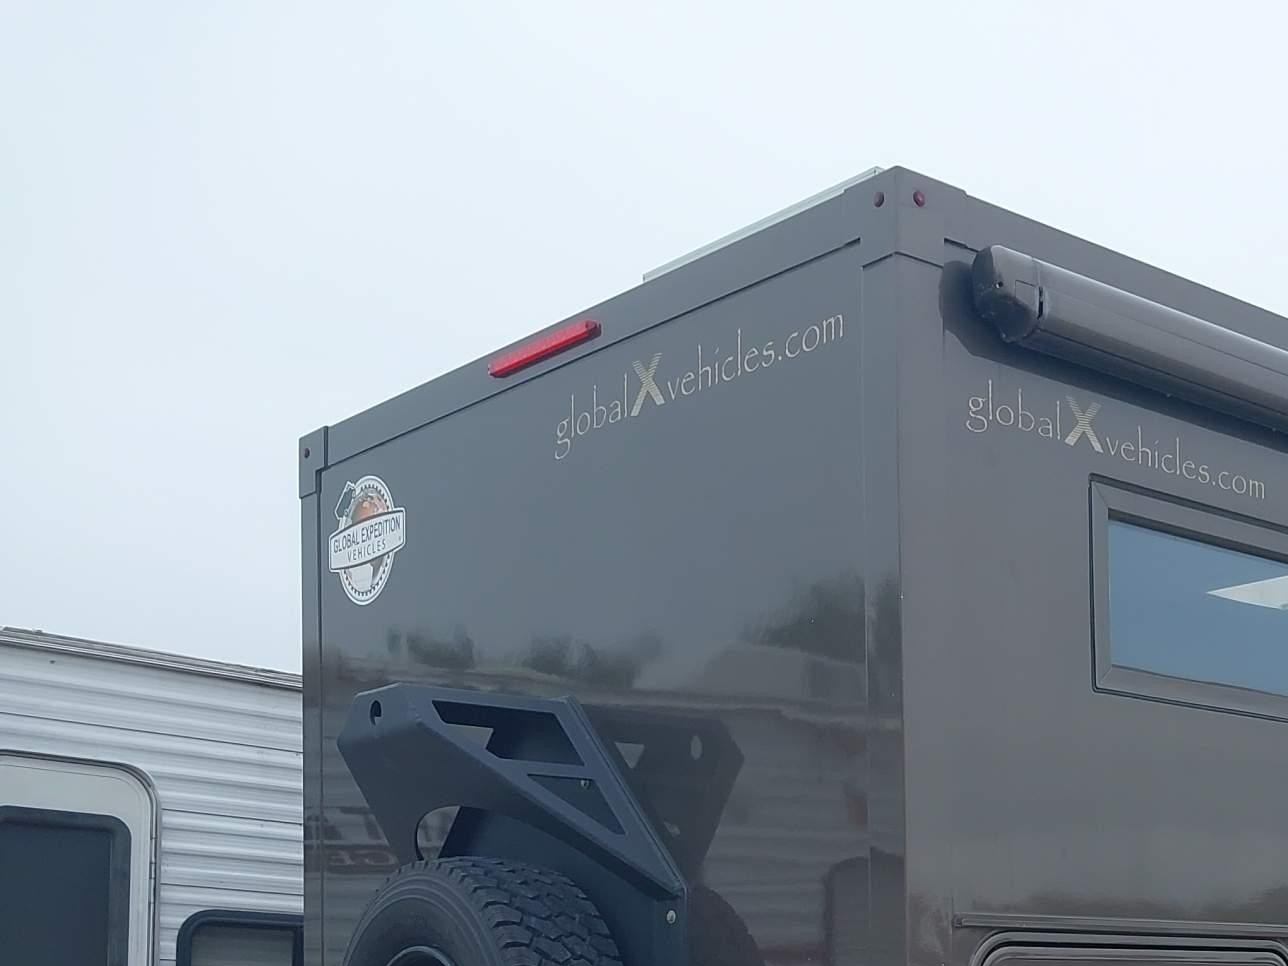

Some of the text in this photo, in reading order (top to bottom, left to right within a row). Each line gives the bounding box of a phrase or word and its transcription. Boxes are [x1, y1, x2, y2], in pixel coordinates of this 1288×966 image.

[554, 312, 844, 460] globalXvehicles.com
[966, 379, 1265, 500] globalXvehicles.com
[333, 516, 401, 554] GLOBAL EXPEDITION
[347, 539, 386, 562] VEHICLES
